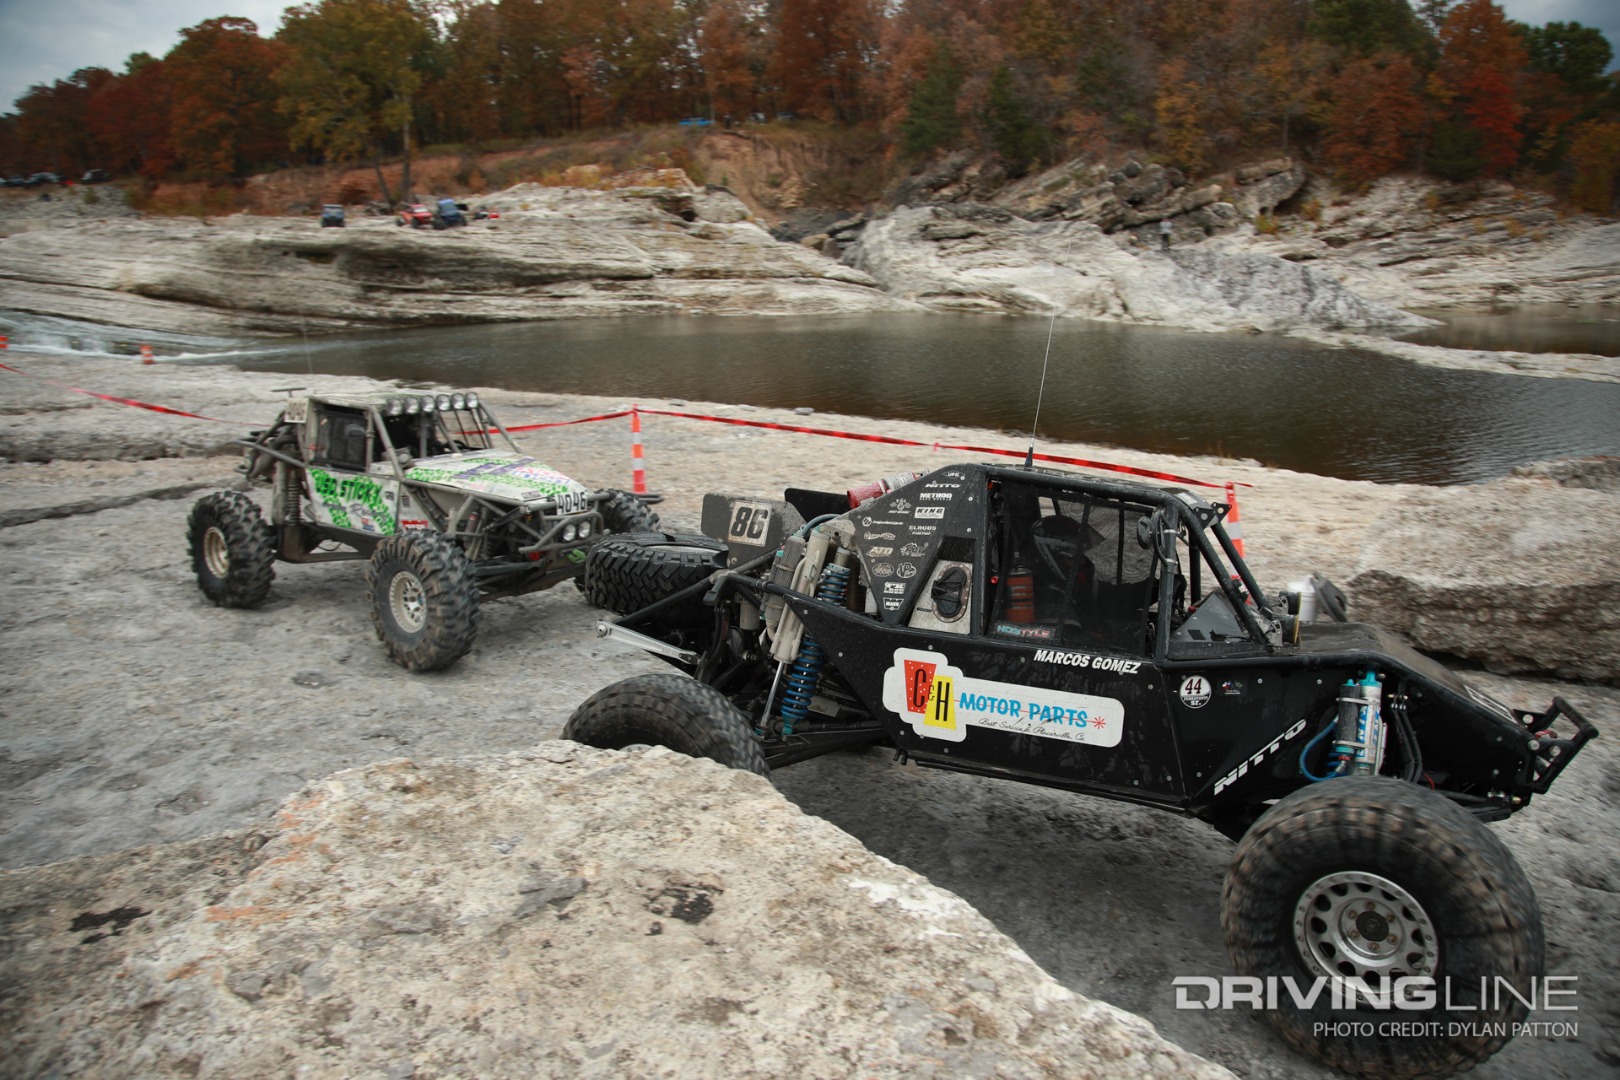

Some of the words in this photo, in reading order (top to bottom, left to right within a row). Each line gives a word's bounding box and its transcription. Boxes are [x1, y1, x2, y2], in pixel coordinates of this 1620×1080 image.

[557, 491, 587, 514] 4046
[730, 506, 769, 539] 86
[1033, 649, 1091, 668] MARCOS
[1092, 656, 1142, 674] GOMEZ
[1185, 678, 1203, 695] 44
[959, 692, 1021, 718] MOTOR
[1028, 703, 1088, 728] PARTS
[1213, 718, 1307, 796] NITTO
